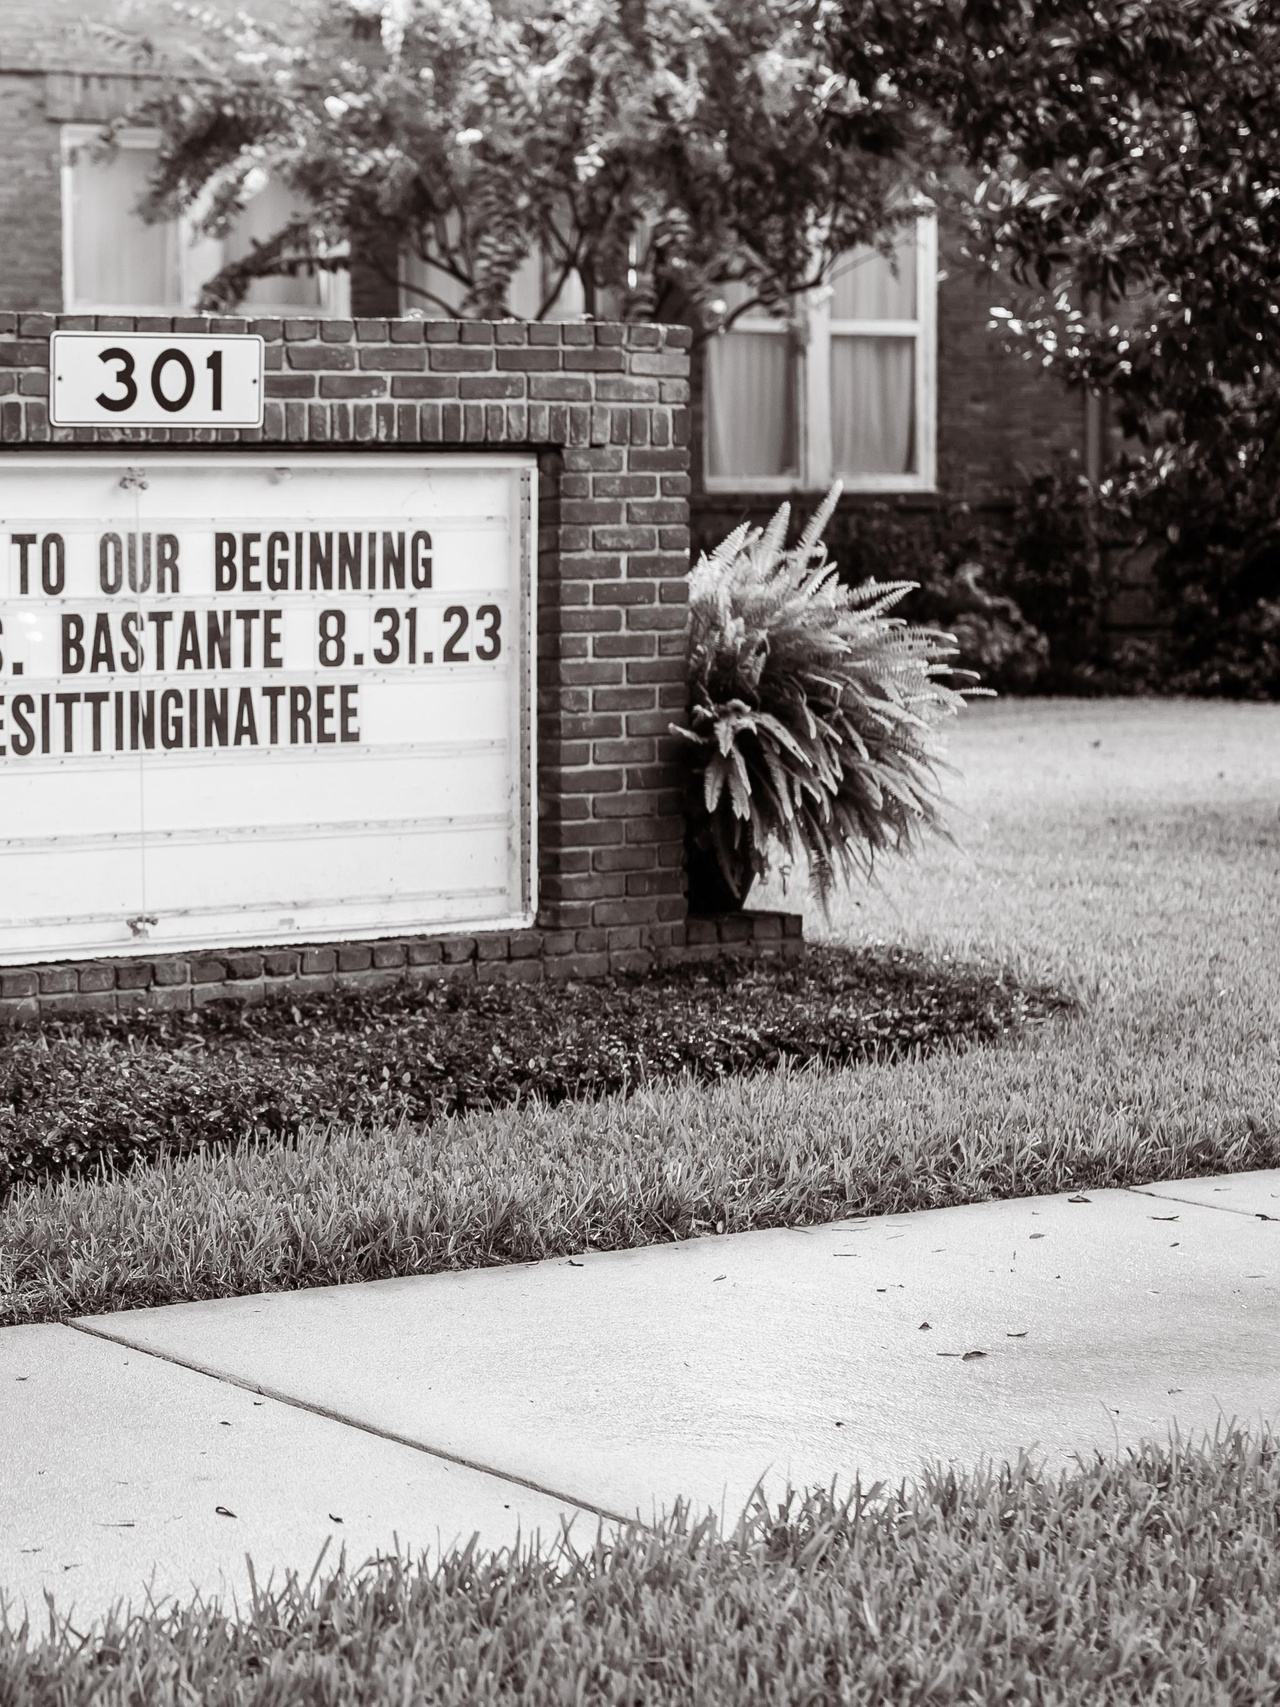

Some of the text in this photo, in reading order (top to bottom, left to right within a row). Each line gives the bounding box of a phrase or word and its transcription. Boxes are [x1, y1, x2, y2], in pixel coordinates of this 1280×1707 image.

[95, 347, 223, 413] 301
[11, 532, 65, 596] TO
[99, 532, 180, 595] OUR
[214, 530, 433, 592] BEGINNING
[61, 609, 283, 675] BASTANTE
[318, 604, 502, 667] 8.31.23
